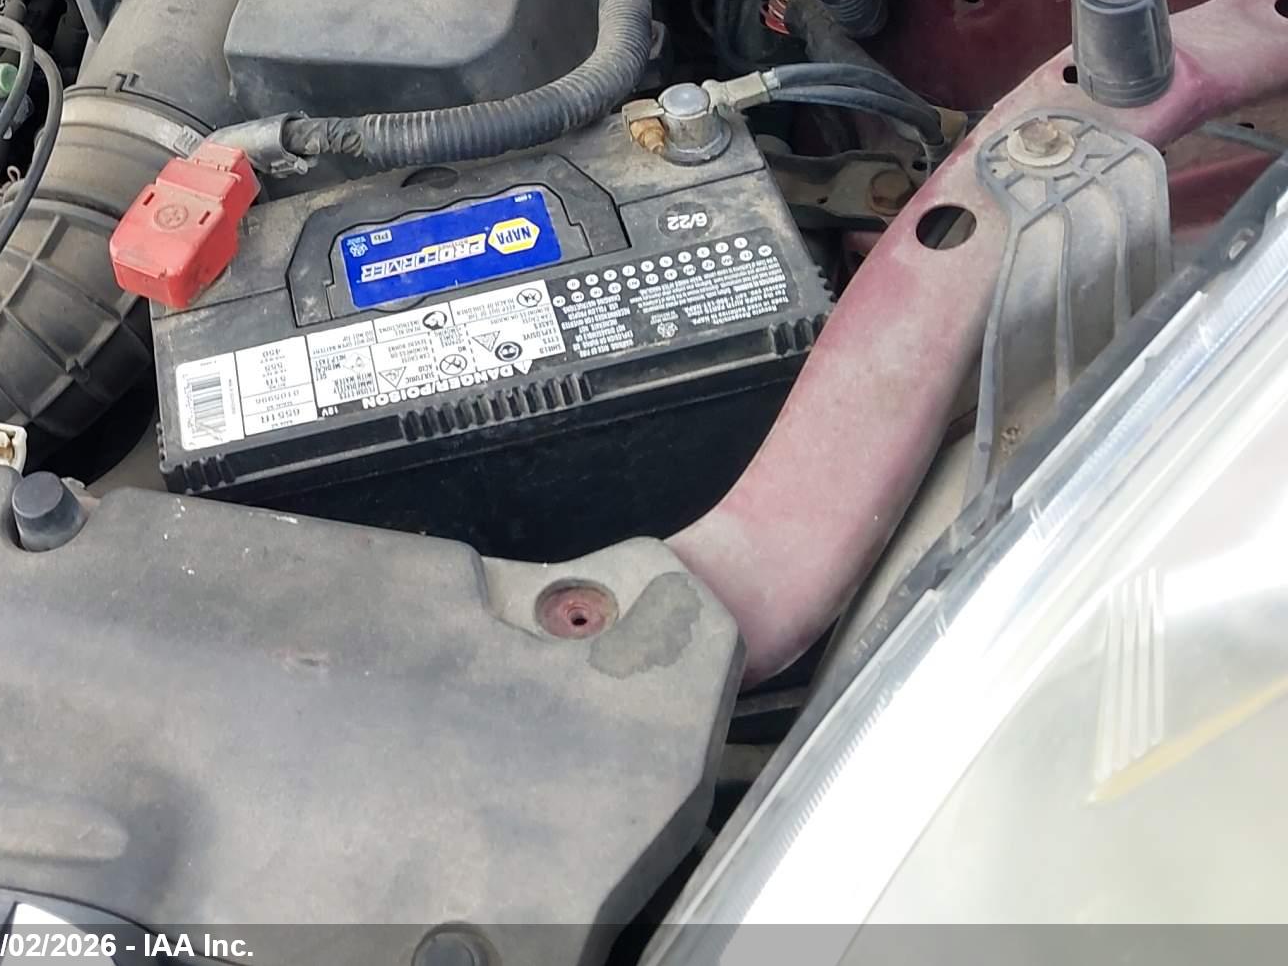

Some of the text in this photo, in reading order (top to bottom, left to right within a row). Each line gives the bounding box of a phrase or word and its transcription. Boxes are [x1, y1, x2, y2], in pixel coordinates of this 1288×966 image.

[667, 212, 707, 230] 6/22
[495, 225, 530, 246] NAPA
[362, 365, 513, 409] DANGER/POISON
